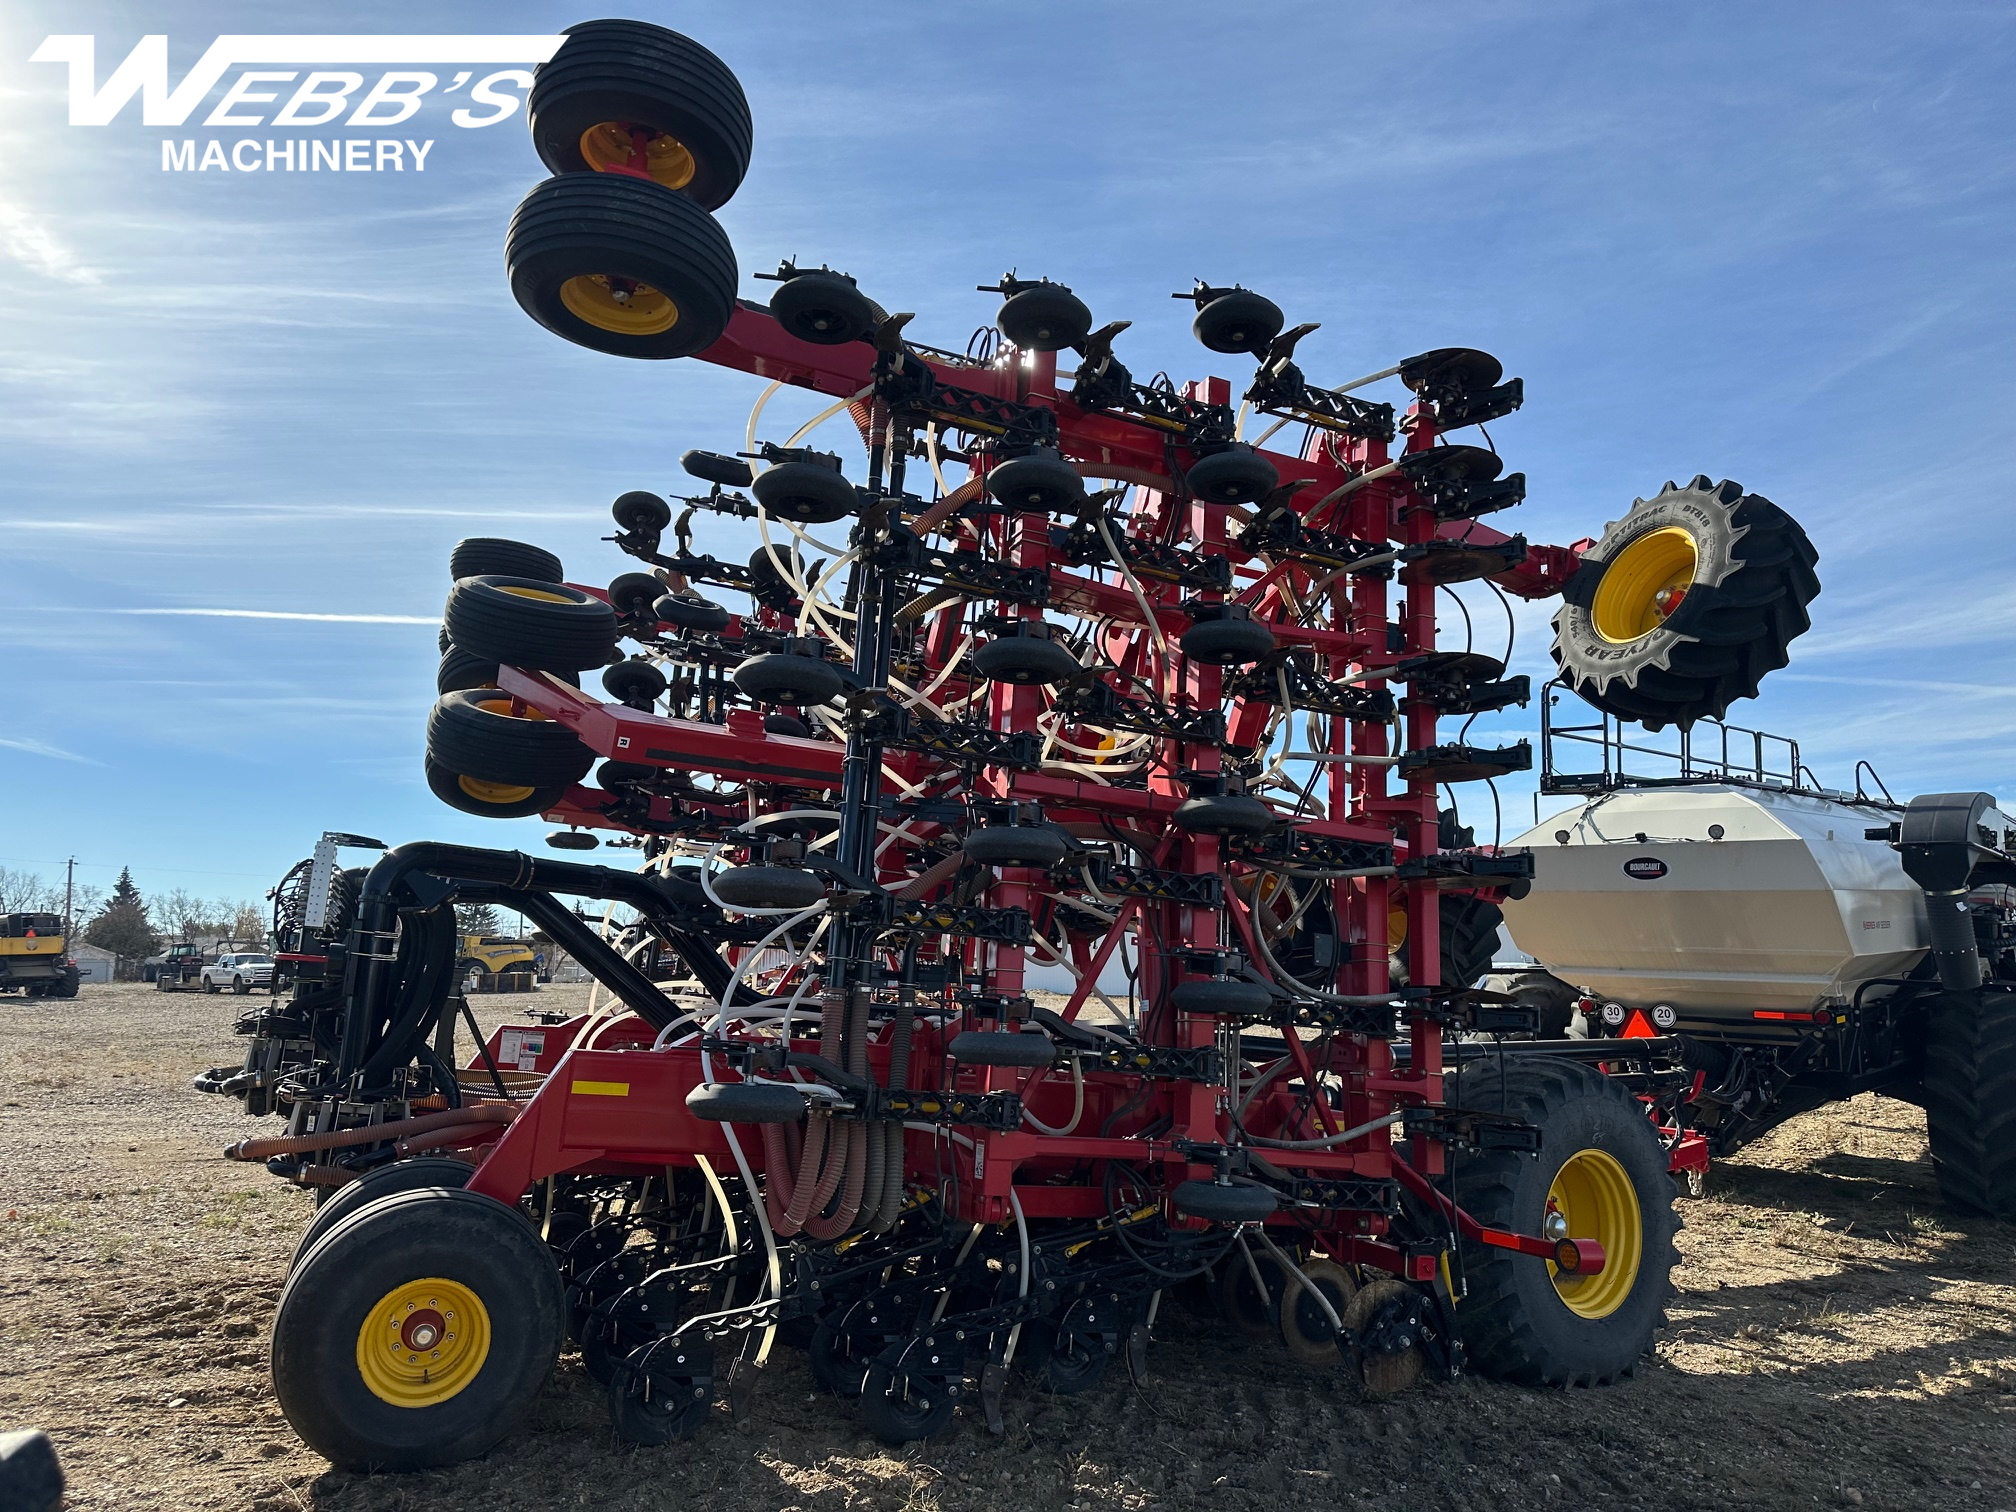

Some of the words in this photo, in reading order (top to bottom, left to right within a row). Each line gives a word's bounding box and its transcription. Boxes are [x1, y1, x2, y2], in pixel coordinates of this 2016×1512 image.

[1602, 505, 1668, 552] OPTITRAC
[1682, 504, 1711, 528] DT818
[1629, 862, 1661, 871] BOURGAULT
[1606, 1006, 1620, 1016] 30
[1657, 1008, 1671, 1019] 20
